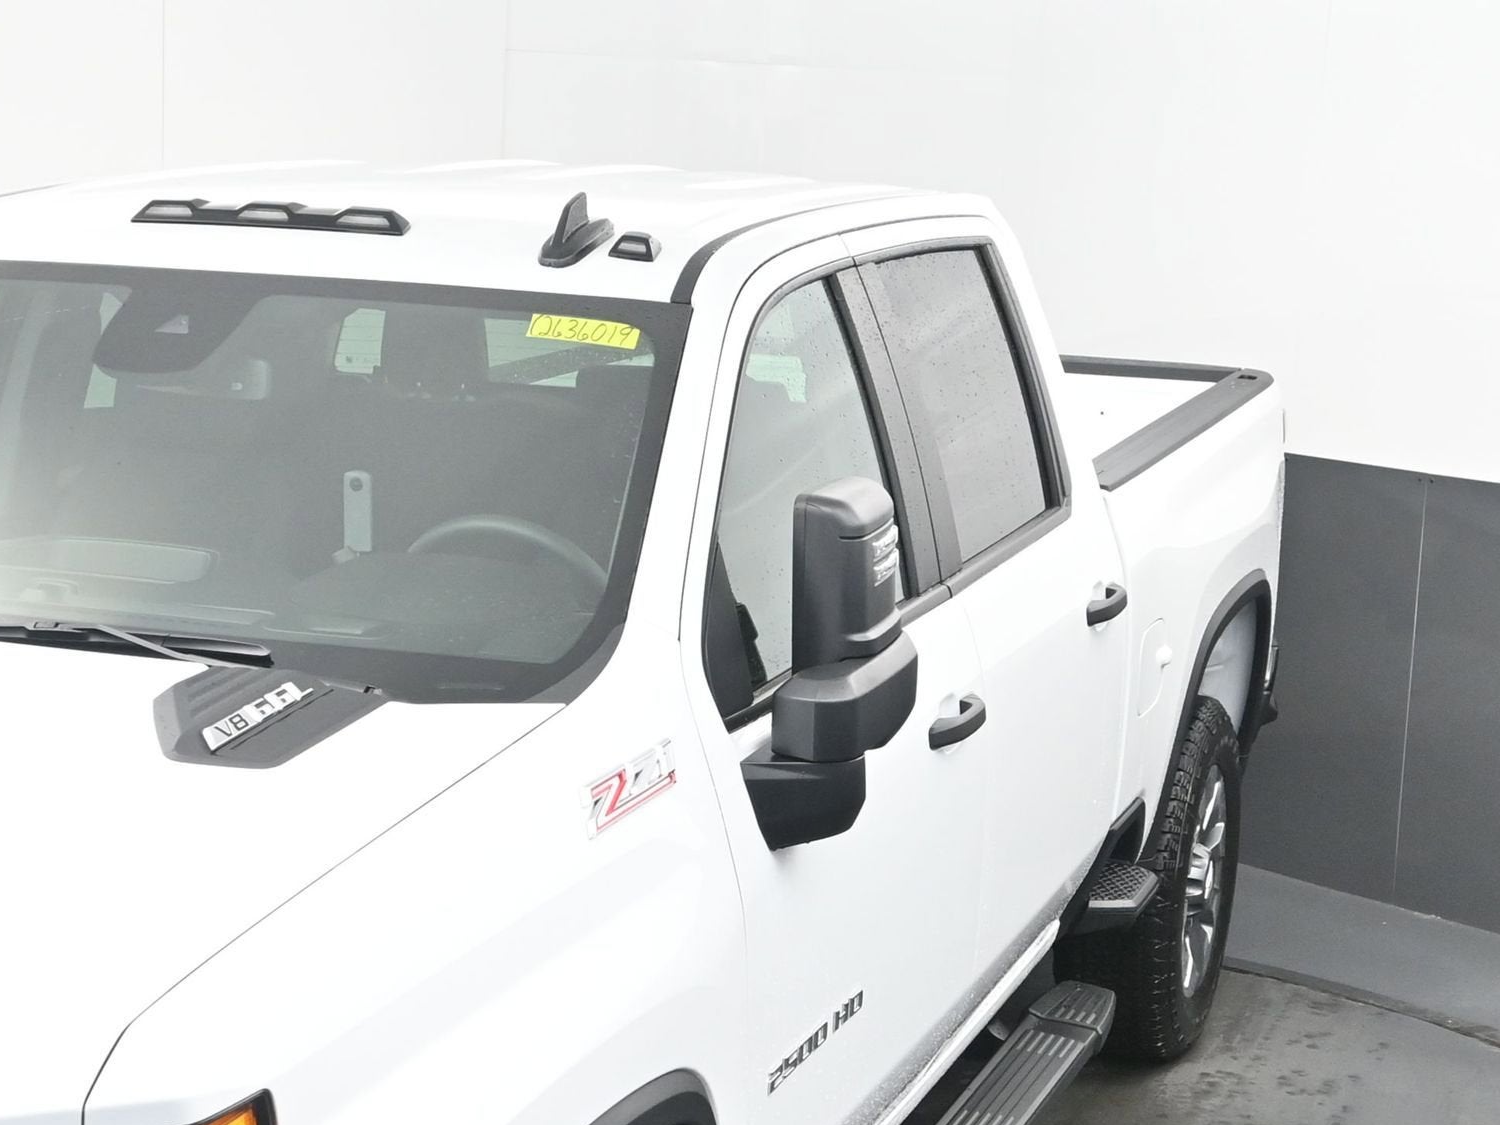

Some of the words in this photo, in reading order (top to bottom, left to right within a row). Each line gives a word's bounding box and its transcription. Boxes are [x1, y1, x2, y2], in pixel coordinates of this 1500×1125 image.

[213, 712, 250, 738] V8
[588, 738, 676, 838] Z71
[767, 1021, 828, 1096] 2500
[833, 989, 863, 1033] HD
